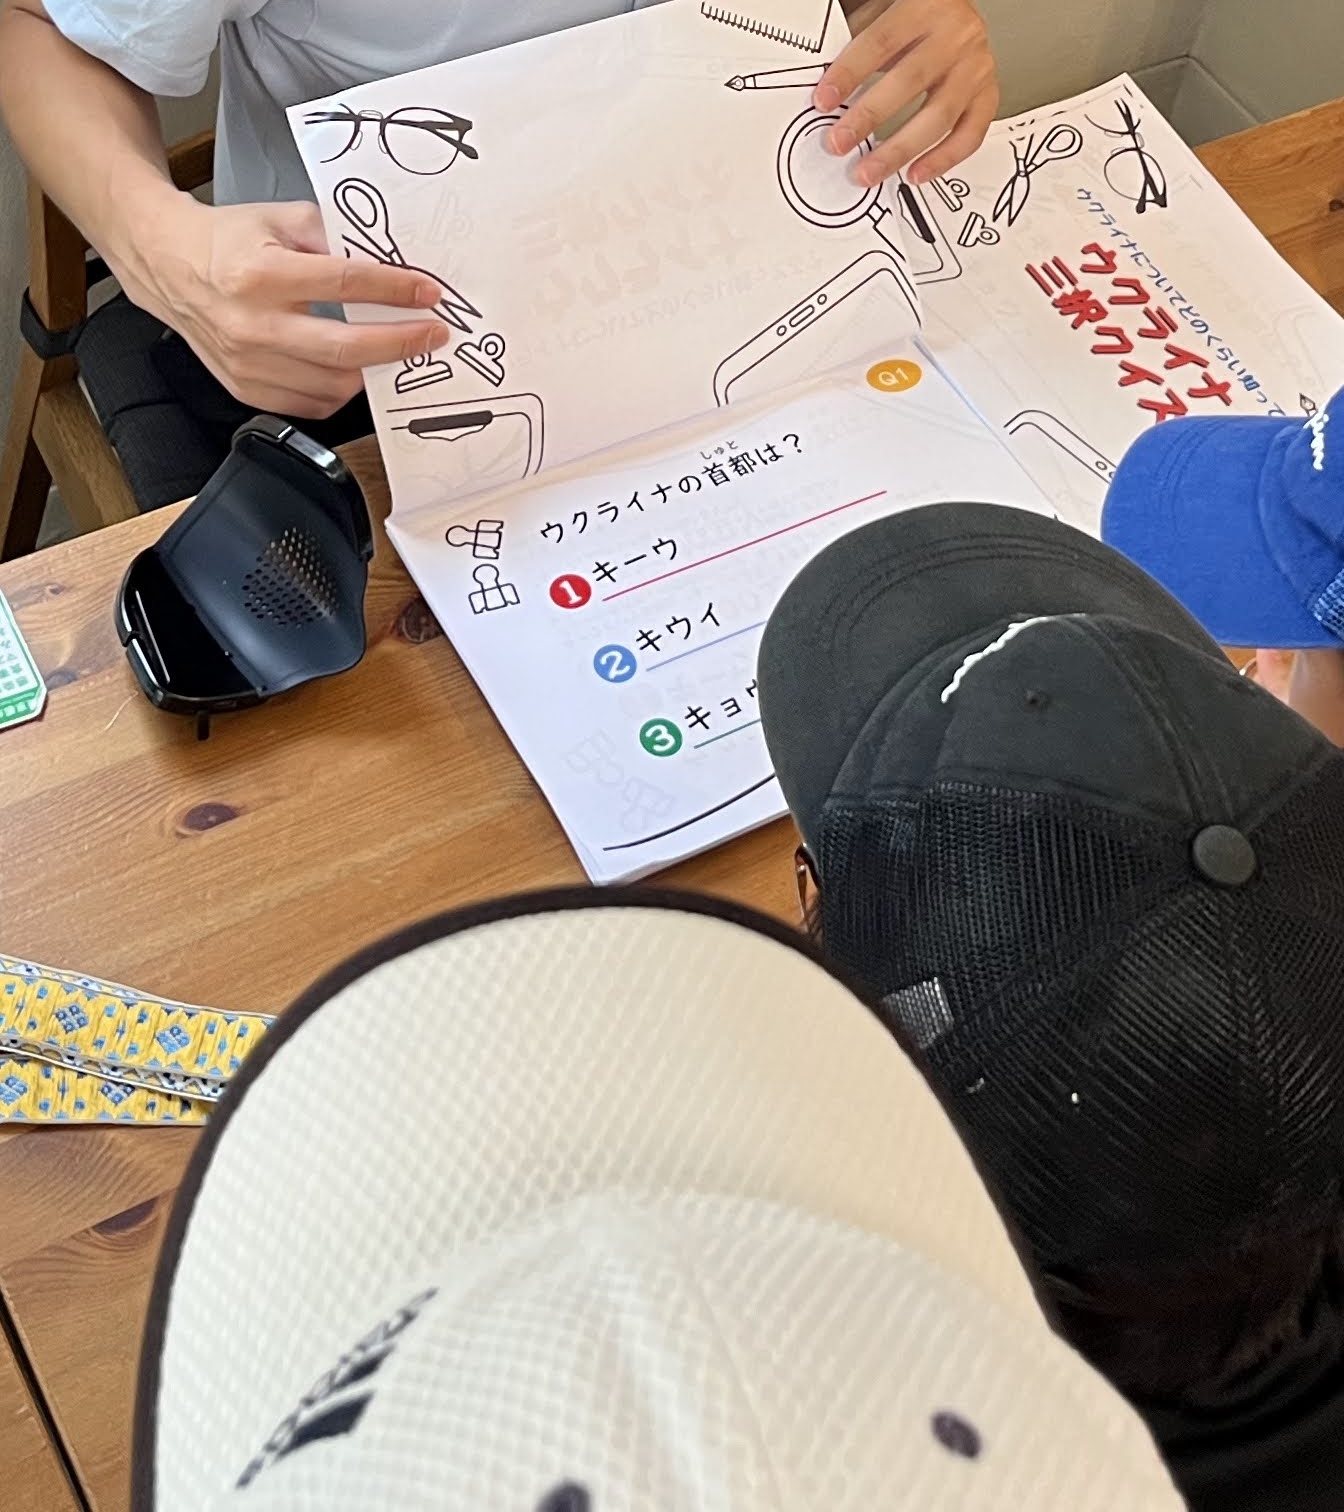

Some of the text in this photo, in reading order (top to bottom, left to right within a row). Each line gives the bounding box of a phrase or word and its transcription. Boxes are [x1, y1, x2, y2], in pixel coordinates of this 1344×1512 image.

[1081, 242, 1233, 406] ウクライナ
[877, 366, 910, 386] Q1
[700, 439, 738, 461] しゅと
[593, 537, 680, 584] キーウ
[636, 601, 722, 653] キウイ
